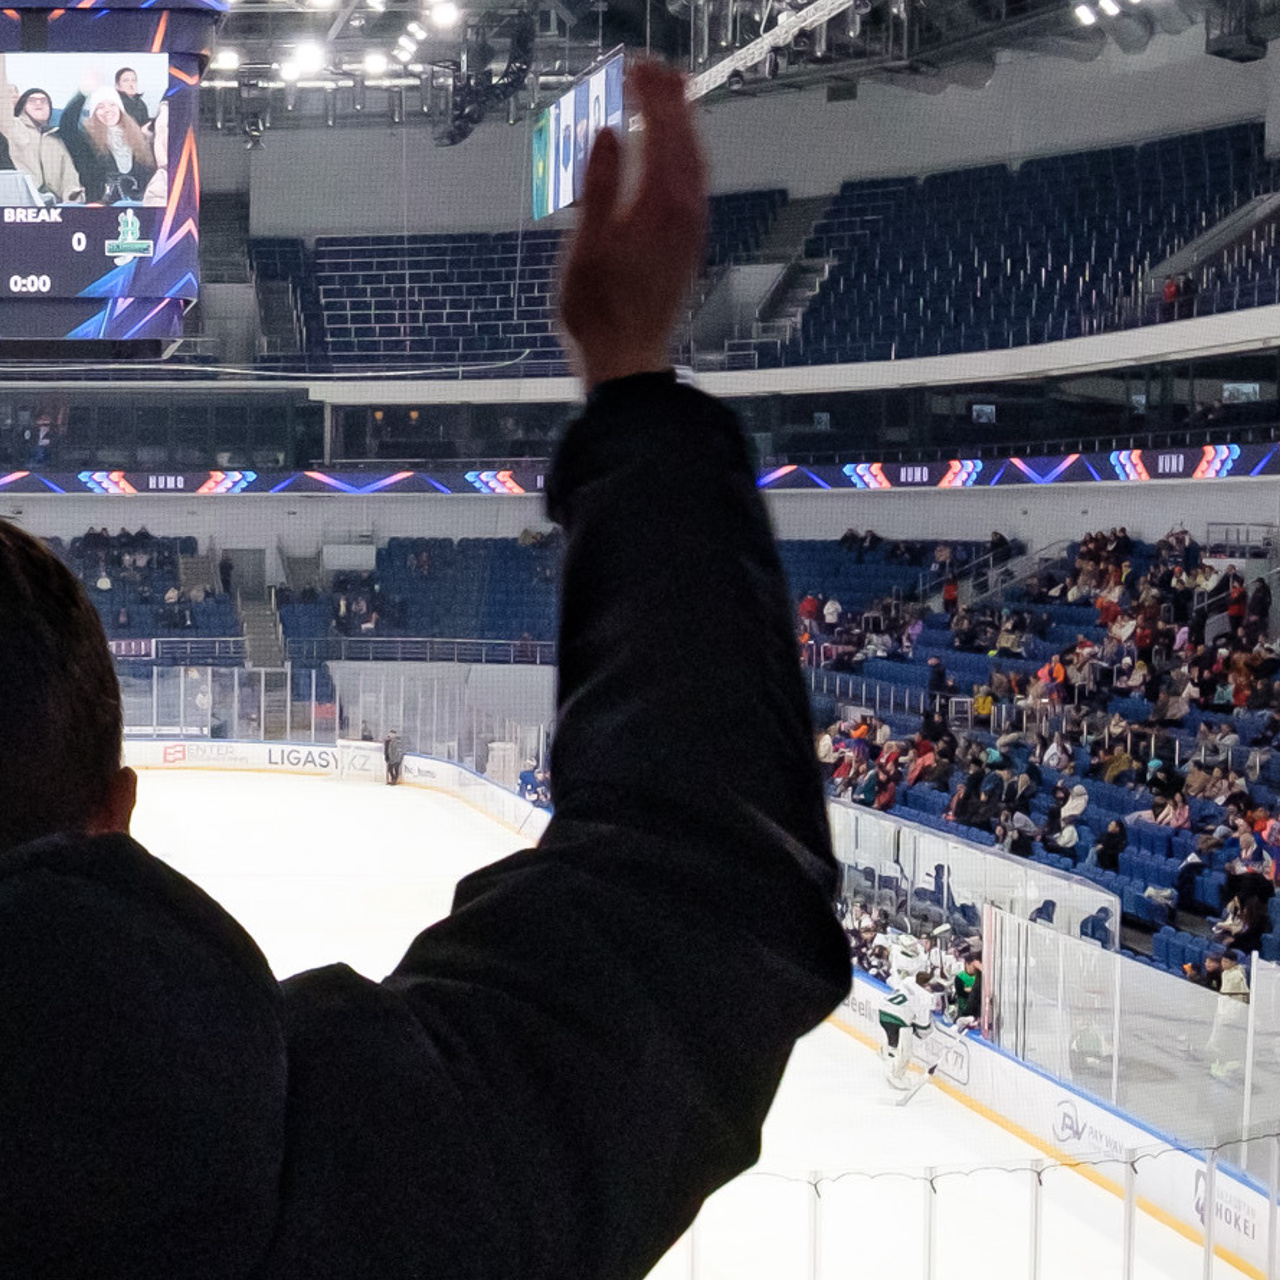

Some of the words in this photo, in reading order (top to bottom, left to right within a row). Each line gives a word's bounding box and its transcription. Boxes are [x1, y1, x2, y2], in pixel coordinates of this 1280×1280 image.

[3, 208, 63, 223] BREAK
[72, 232, 87, 251] 0
[9, 275, 51, 292] 0:00
[149, 475, 184, 489] HUMO
[900, 466, 929, 482] HUMO
[1215, 1201, 1255, 1240] HOKEI
